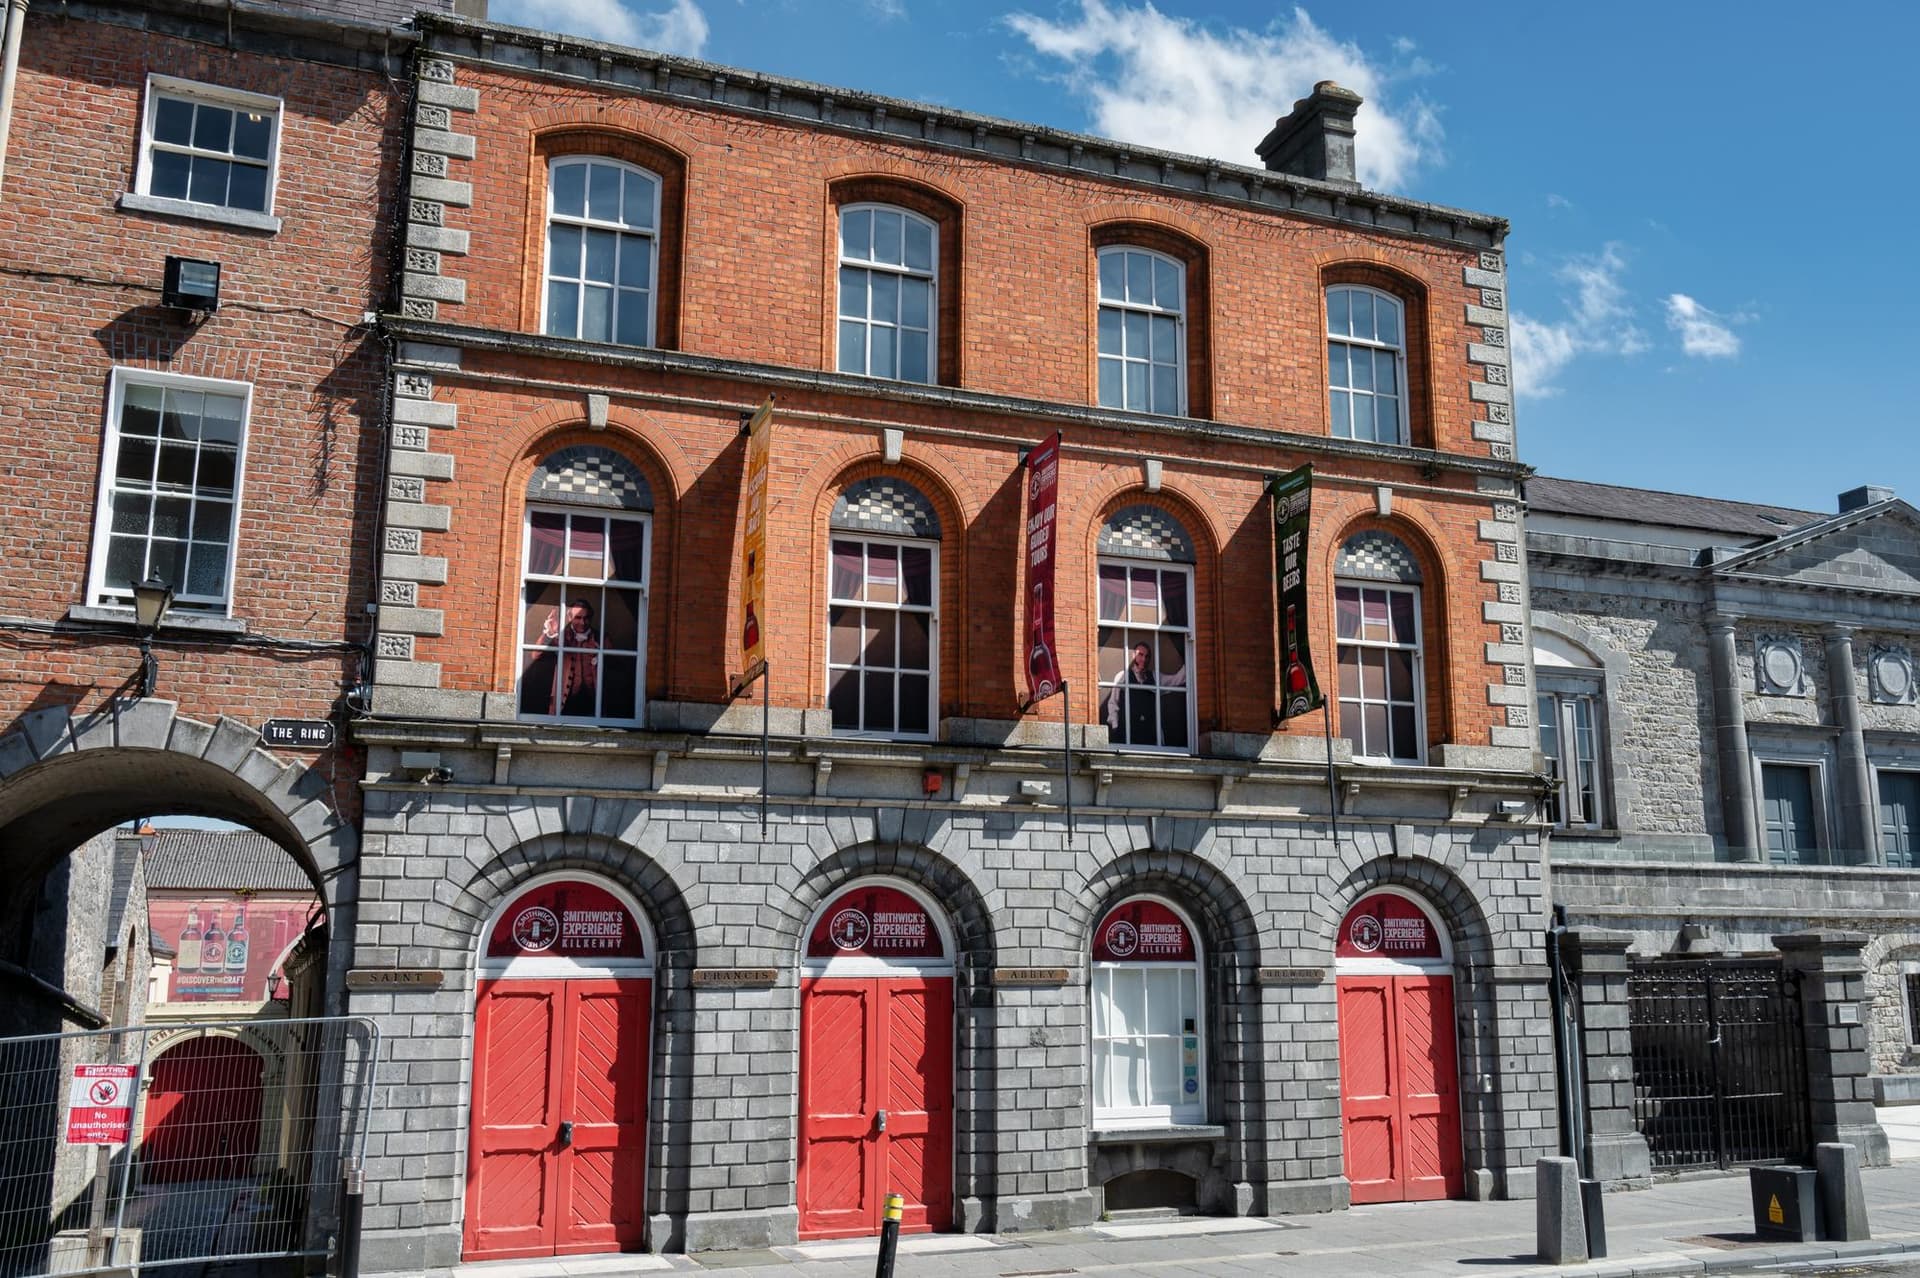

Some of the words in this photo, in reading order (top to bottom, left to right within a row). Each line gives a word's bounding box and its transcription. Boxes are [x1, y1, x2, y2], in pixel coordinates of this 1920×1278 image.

[1028, 512, 1043, 535] ENJOY
[1043, 504, 1055, 523] OUR
[1282, 531, 1301, 555] TASTE
[1031, 544, 1048, 568] TOURS
[1285, 553, 1297, 572] OUR
[1282, 569, 1301, 593] BEERS
[272, 727, 293, 738] THE
[300, 727, 326, 739] RING
[562, 910, 623, 922] SMITHWICK'S
[873, 912, 926, 923] SMITHWICK'S
[1140, 924, 1182, 933] SMITHWICK'S
[1384, 918, 1425, 928] SMITHWICK'S
[562, 923, 622, 935] EXPERIENCE
[873, 924, 926, 935] EXPERIENCE
[1384, 928, 1425, 938] EXPERIENCE
[562, 938, 622, 949] KILKENNY
[873, 938, 925, 947] KILKENNY
[1140, 933, 1182, 943] EXPERIENCE
[369, 972, 423, 982] SAINT
[703, 971, 769, 980] FRANCIS
[1010, 970, 1055, 979] ABBEY
[87, 1132, 110, 1140] entry
